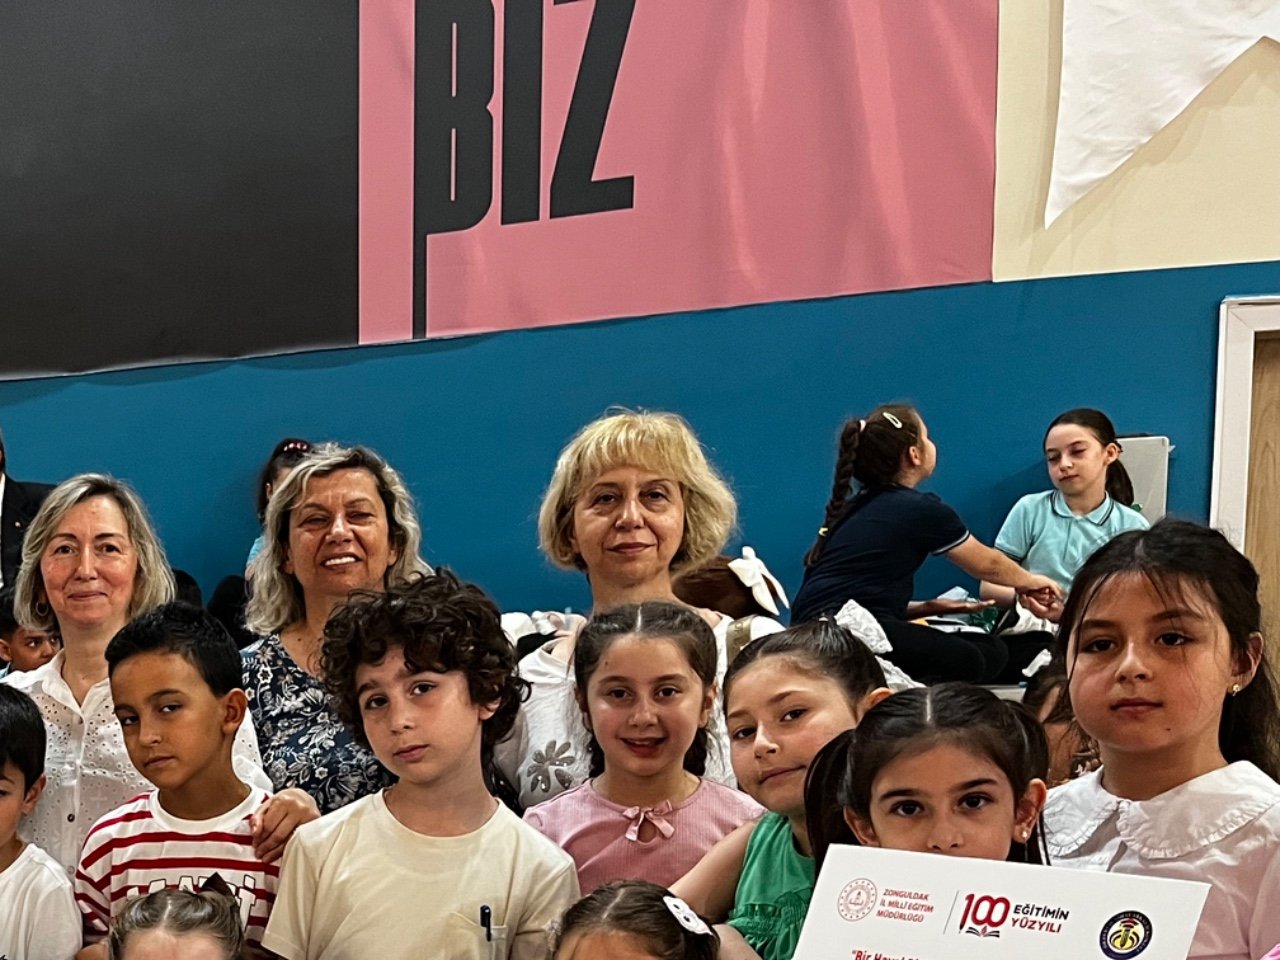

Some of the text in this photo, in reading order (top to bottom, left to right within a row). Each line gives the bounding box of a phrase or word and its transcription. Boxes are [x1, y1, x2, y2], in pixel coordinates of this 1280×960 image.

[883, 888, 929, 901] ZONGULDAK
[960, 893, 1011, 930] 100
[1013, 903, 1070, 921] EĞİTİMİN
[1011, 917, 1062, 933] YÜZYILI
